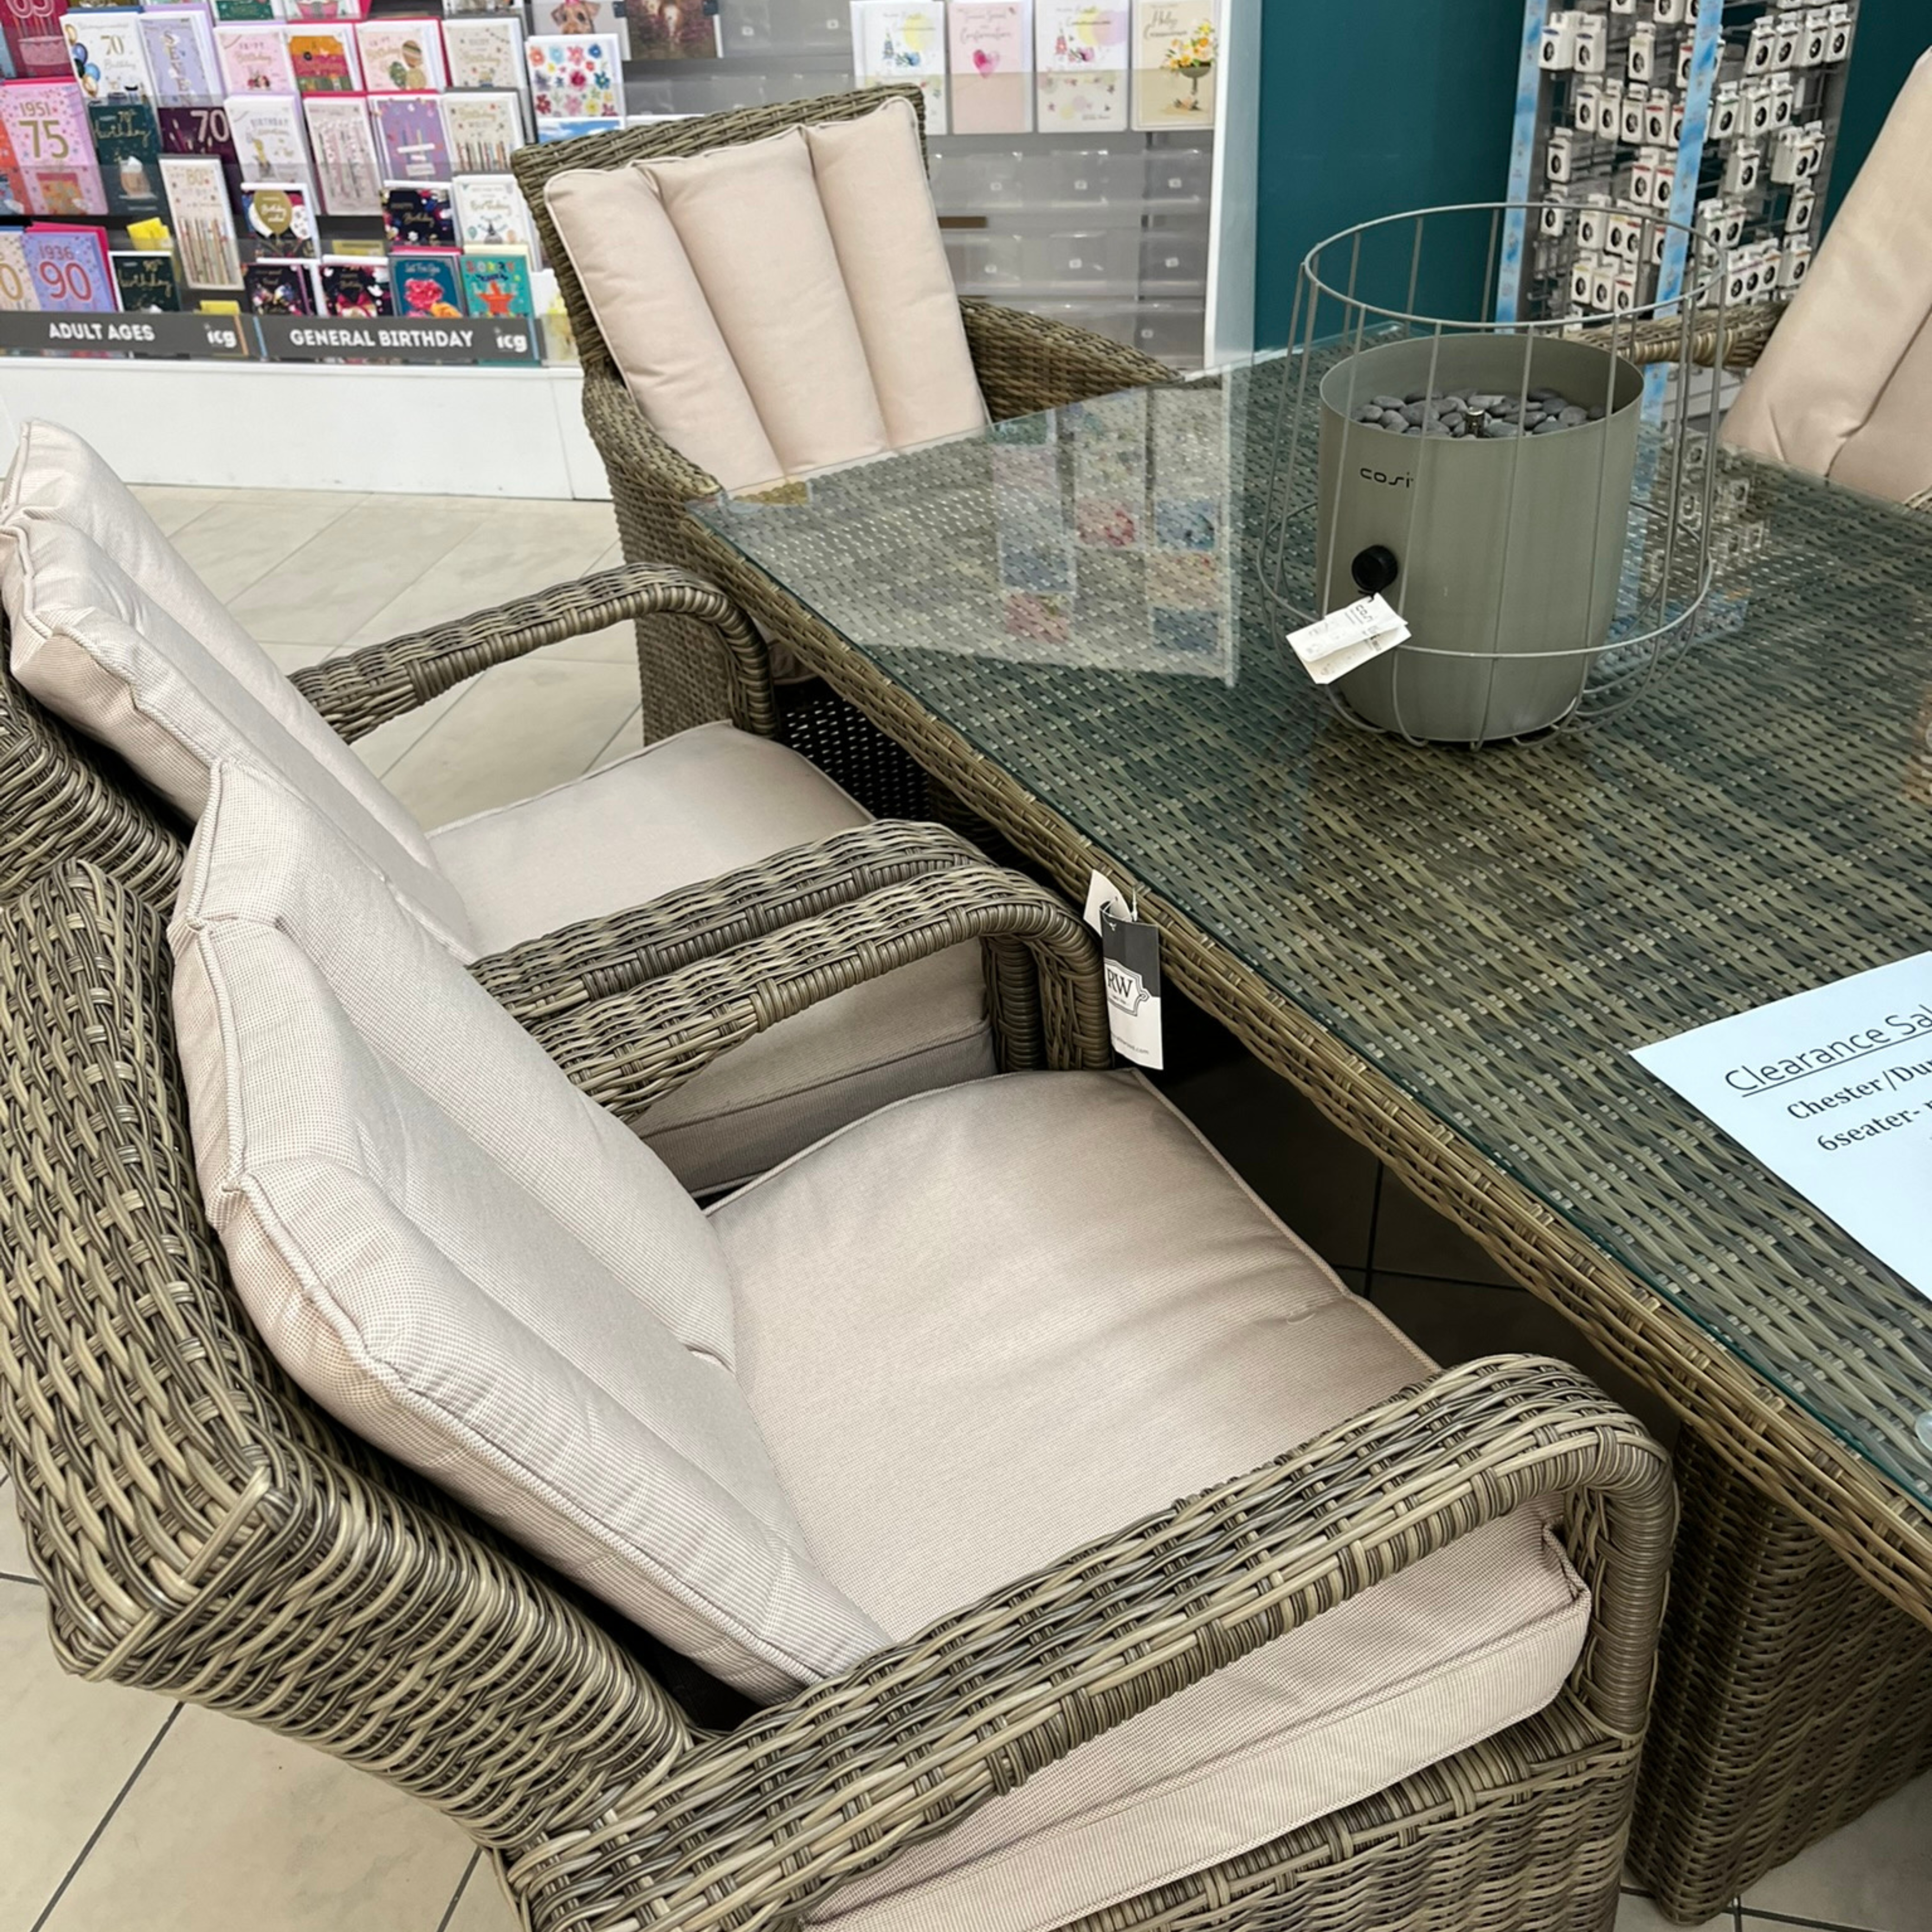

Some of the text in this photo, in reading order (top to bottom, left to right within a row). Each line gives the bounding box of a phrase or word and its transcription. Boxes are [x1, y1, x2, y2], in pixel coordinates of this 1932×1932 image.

[19, 120, 69, 159] 75
[190, 109, 229, 142] 70
[39, 261, 92, 301] 90
[49, 323, 155, 341] ADULT AGES
[290, 329, 473, 347] GENERAL BIRTHDAY
[1360, 468, 1414, 488] cosi
[1107, 966, 1133, 998] RW
[1725, 1028, 1891, 1091] Clearance
